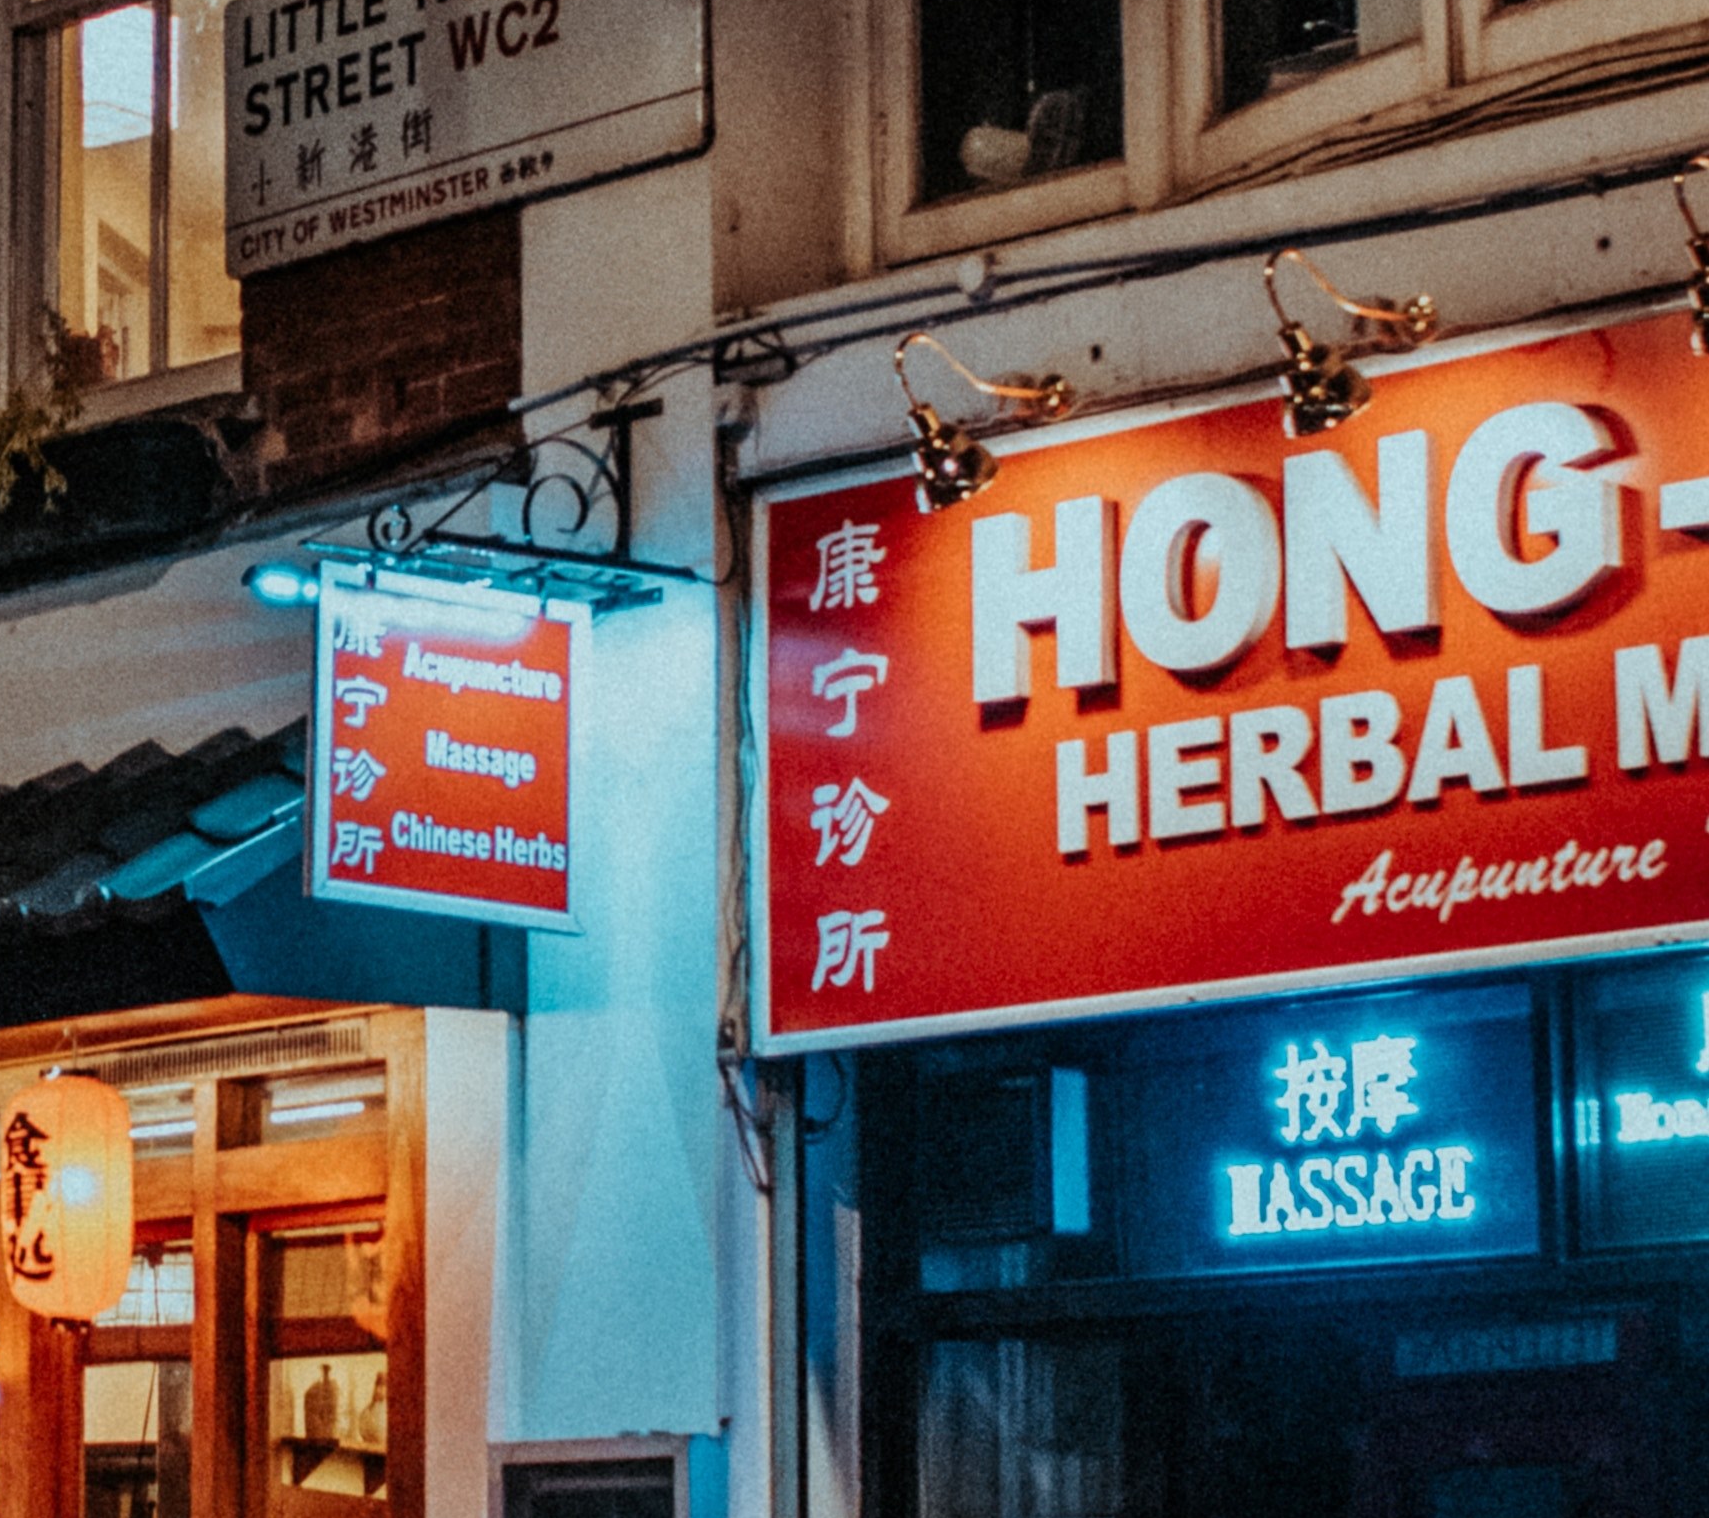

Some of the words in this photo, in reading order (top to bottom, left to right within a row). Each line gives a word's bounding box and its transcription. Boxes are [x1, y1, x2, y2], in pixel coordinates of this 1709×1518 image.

[242, 31, 427, 137] STREET
[239, 224, 287, 262] CITY
[292, 214, 321, 248] OF
[328, 167, 490, 235] WESTMINSTER
[424, 728, 537, 789] Massage
[808, 517, 890, 994] 康宁诊所
[1055, 664, 1589, 855] HERBAL
[391, 809, 491, 862] Chinese
[494, 825, 567, 872] Herbs
[1274, 1033, 1421, 1144] 按摩
